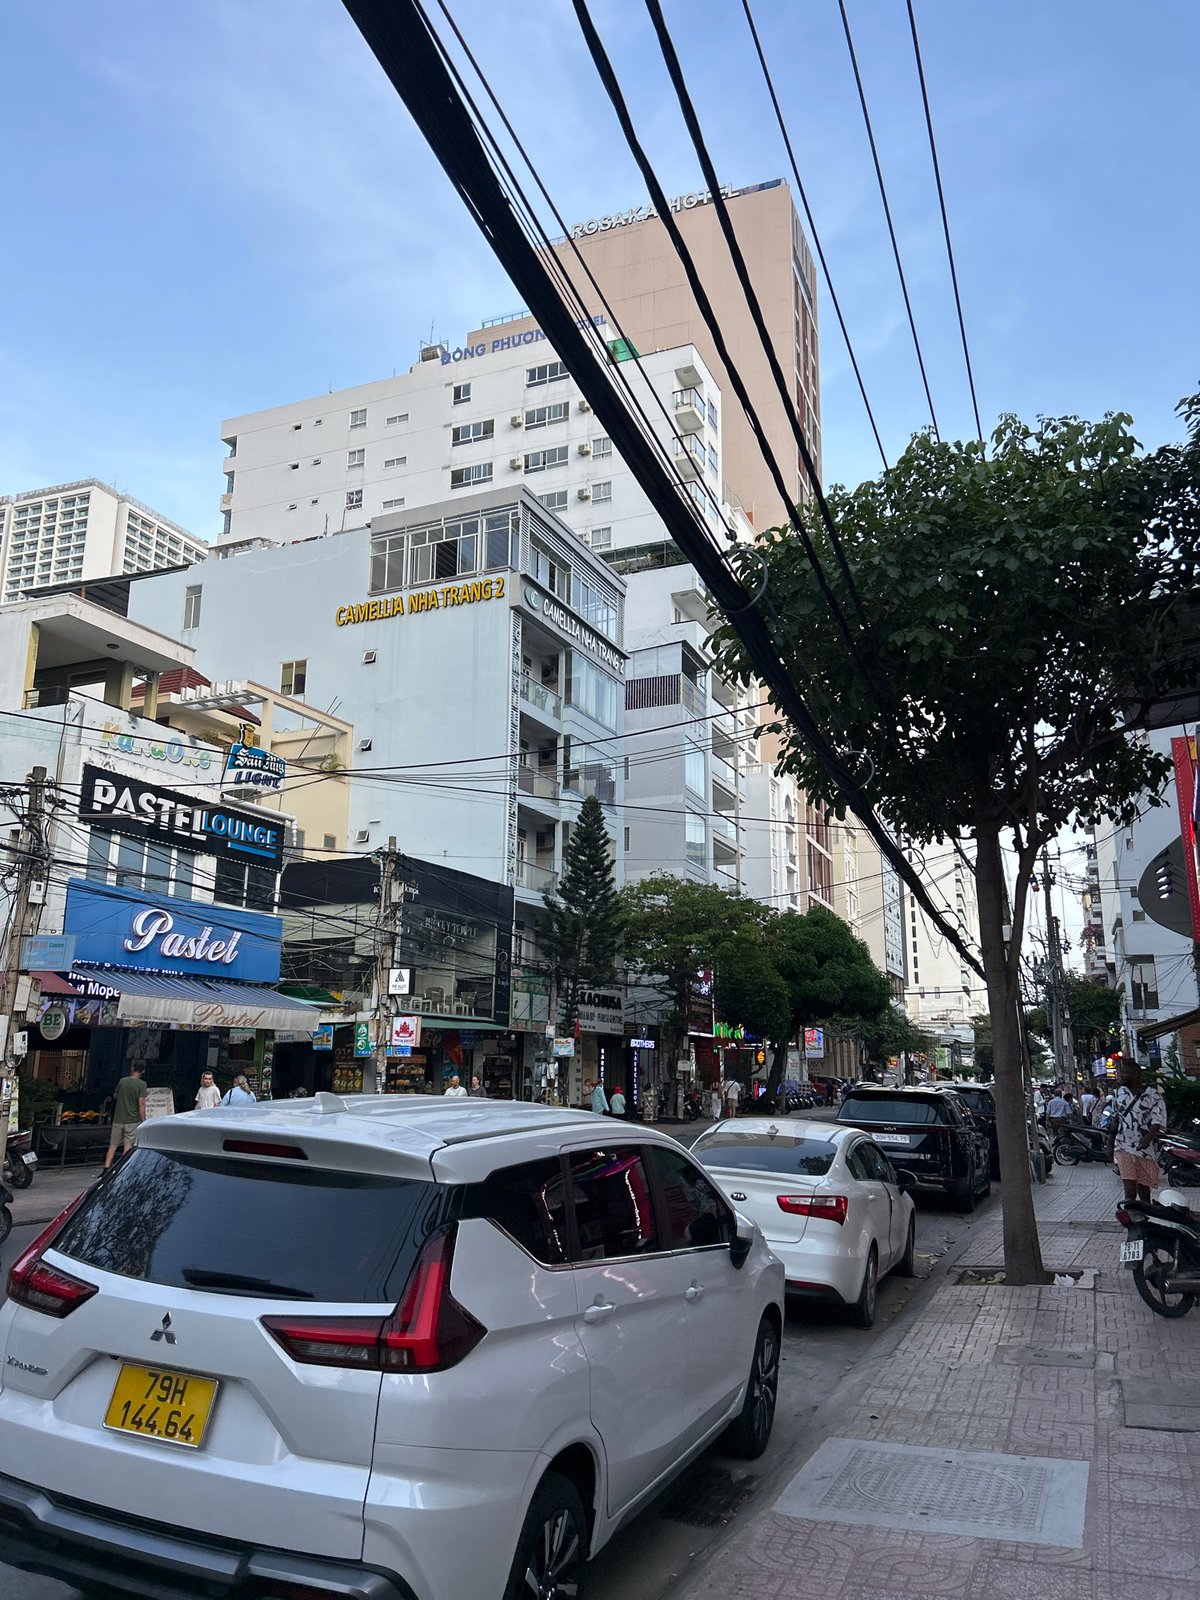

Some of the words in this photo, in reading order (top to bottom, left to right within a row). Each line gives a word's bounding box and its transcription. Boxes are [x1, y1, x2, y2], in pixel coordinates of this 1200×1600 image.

[570, 204, 658, 240] ROSAKA
[335, 596, 404, 627] CAMELLIA
[408, 589, 440, 614] NHA
[441, 579, 492, 607] TRANG
[495, 576, 505, 598] 2
[543, 598, 581, 640] CAMELLIA
[581, 628, 596, 653] NHA
[597, 640, 620, 671] TRANG
[619, 658, 625, 674] 2
[92, 778, 207, 841] PASTEL
[201, 810, 278, 849] LOUNGE
[123, 908, 242, 964] Pastel
[194, 1003, 266, 1028] Pastel
[630, 1039, 655, 1049] BROTHERS
[144, 1371, 189, 1406] 79H
[121, 1400, 196, 1441] 144.64
